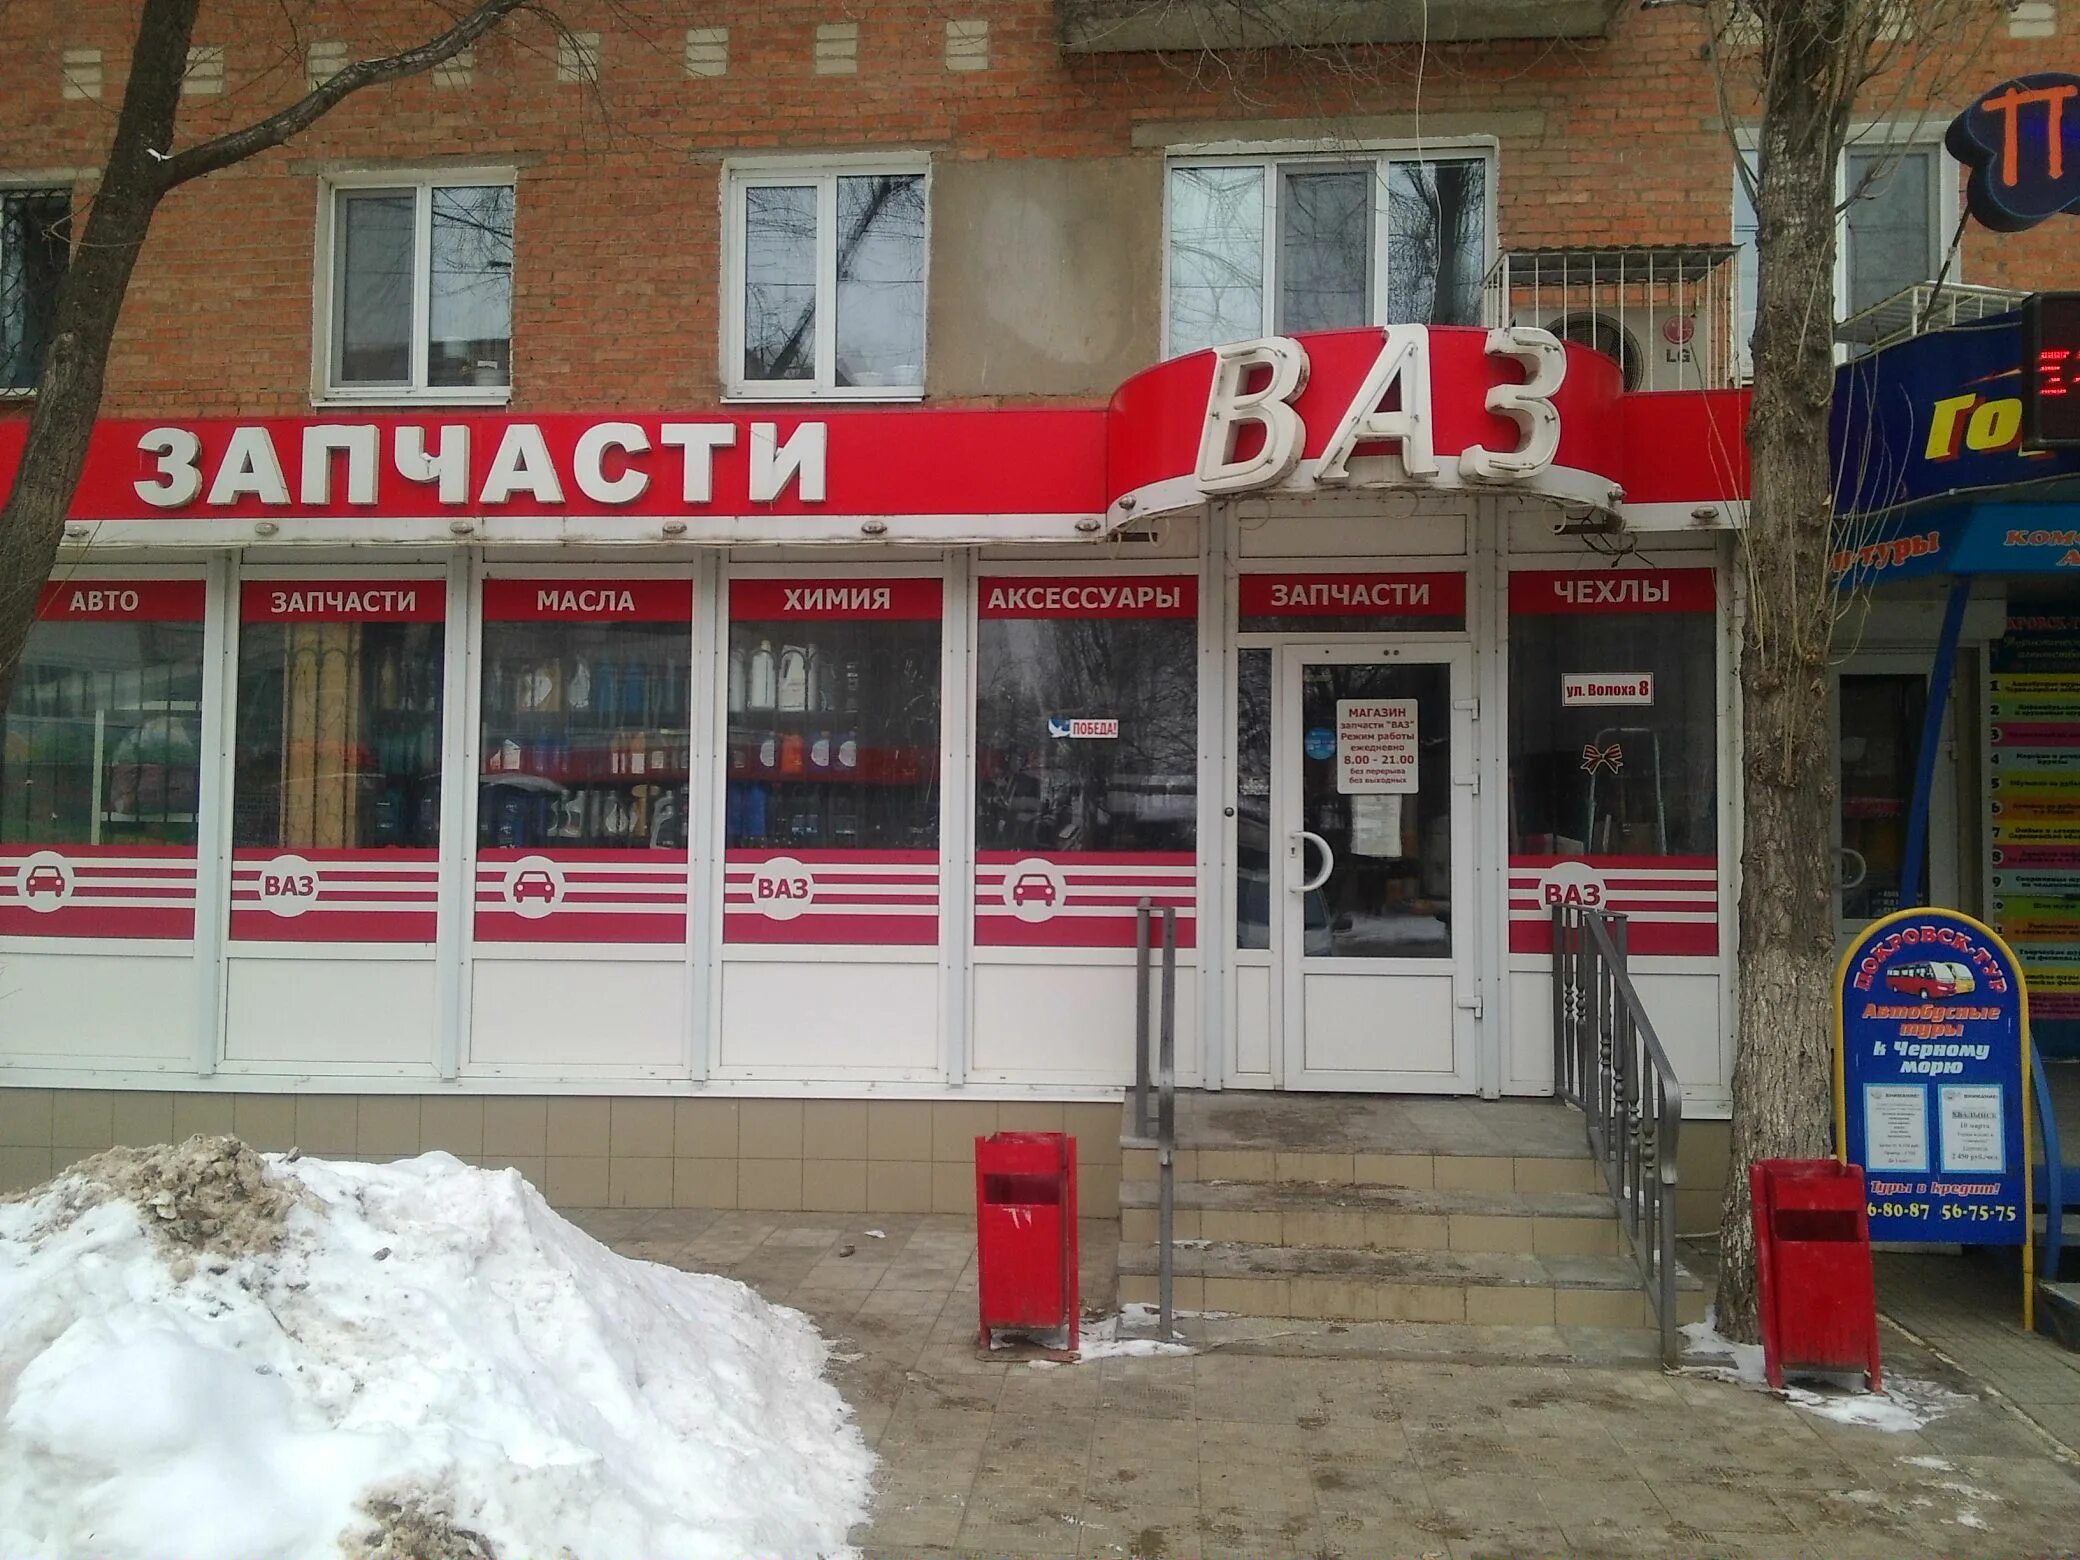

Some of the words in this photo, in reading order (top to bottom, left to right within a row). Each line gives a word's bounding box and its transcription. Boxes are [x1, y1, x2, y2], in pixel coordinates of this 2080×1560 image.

[1666, 349, 1690, 363] LG
[1195, 324, 1567, 495] ВАЗ
[133, 421, 828, 508] ЗАПЧАСТИ
[784, 588, 891, 611] ХИМИЯ
[988, 587, 1181, 610] АКСЕССУАРЫ
[1271, 584, 1430, 608] ЗАПЧАСТИ
[1554, 579, 1671, 604] ЧЕХЛЫ
[69, 590, 139, 612] АВТО
[271, 591, 417, 613] ЗАПЧАСТИ
[537, 590, 636, 612] МАСЛА
[1566, 686, 1585, 698] ул.
[1588, 684, 1636, 697] Волоха
[1639, 680, 1649, 696] 8
[1990, 680, 1999, 691] 1
[1349, 708, 1406, 717] МАГАЗИН
[1990, 704, 1999, 715] 2
[1073, 721, 1117, 736] ПОБЕДА!
[1386, 721, 1415, 729] "ВАЗ"
[1341, 733, 1375, 741] Режим
[1377, 732, 1415, 742] работы
[1351, 745, 1405, 753] ежедневно
[1344, 755, 1370, 765] 8.00
[1382, 755, 1414, 765] 21.00
[1991, 753, 1999, 765] 4
[1991, 778, 2000, 789] 5
[1991, 802, 2000, 813] 6
[1992, 827, 2001, 838] 7
[1992, 851, 2002, 862] 8
[265, 875, 314, 898] ВАЗ
[758, 877, 809, 900] ВАЗ
[1993, 876, 2002, 887] 9
[1545, 882, 1601, 907] ВАЗ
[1853, 925, 2008, 994] ПОКРОВСК-ТУР
[1862, 1003, 2001, 1023] Автобусные
[1899, 1022, 1964, 1040] туры
[1873, 1041, 1887, 1056] к
[1893, 1041, 1990, 1060] Черному
[1900, 1060, 1964, 1076] морю
[1871, 1180, 1912, 1195] Туры
[1916, 1183, 1927, 1194] в
[1931, 1181, 2000, 1197] кредит!
[1867, 1201, 1930, 1220] 6-80-87
[1941, 1203, 2017, 1222] 56-75-75
